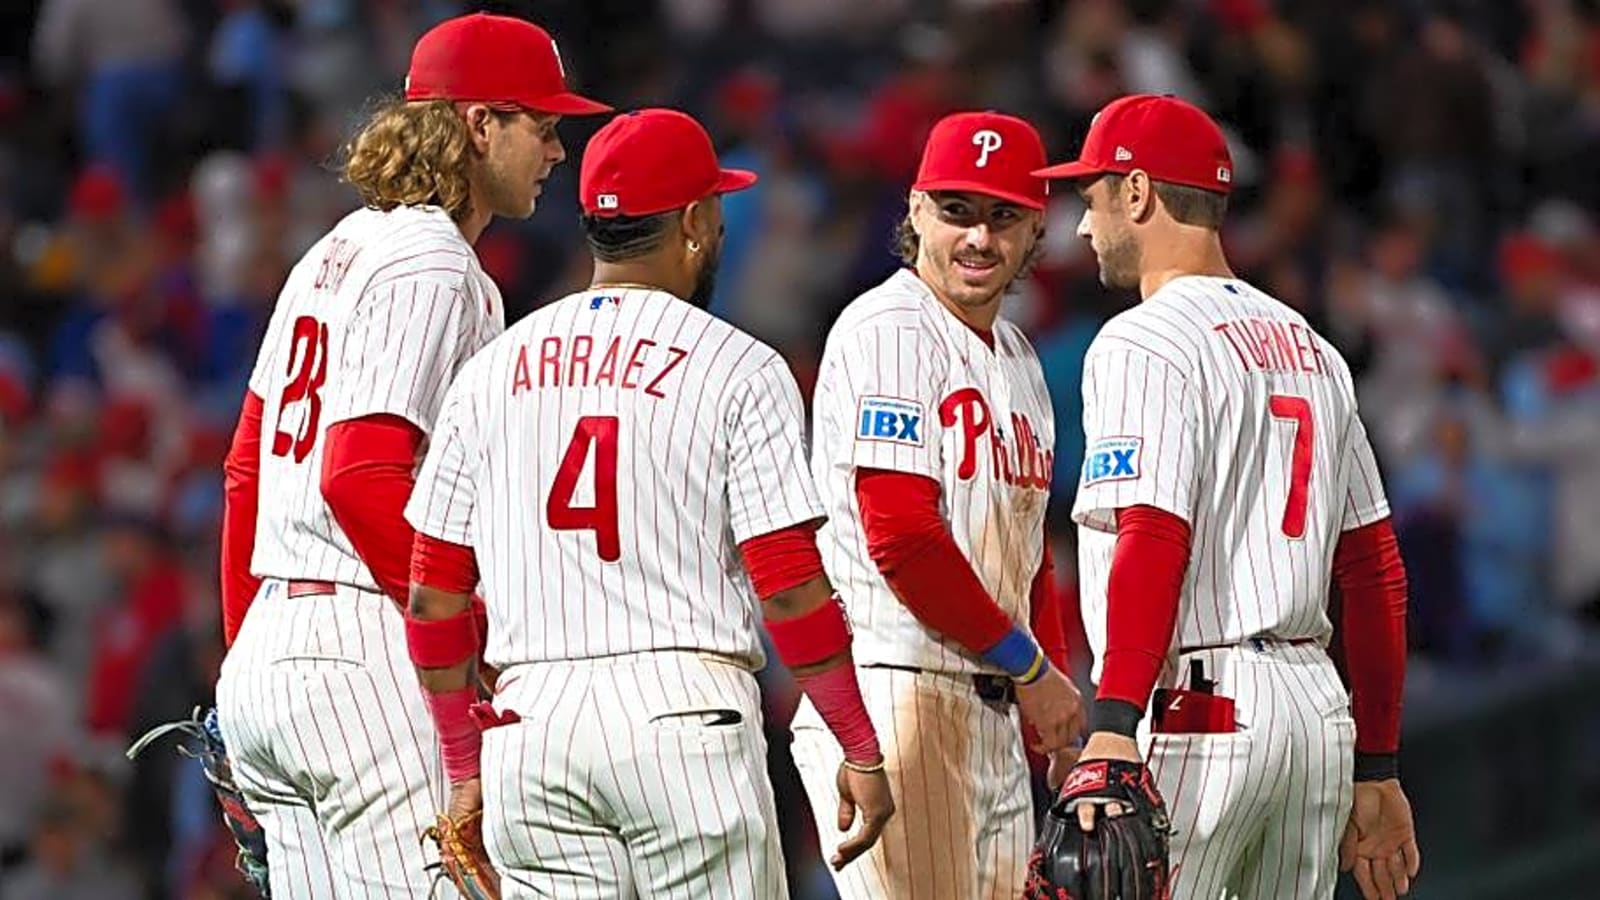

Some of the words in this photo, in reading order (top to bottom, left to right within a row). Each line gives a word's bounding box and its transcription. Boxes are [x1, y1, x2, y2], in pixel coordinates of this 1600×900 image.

[972, 130, 1002, 167] P
[512, 335, 688, 399] ARRAEZ
[860, 409, 921, 442] IBX
[546, 415, 621, 562] 4
[1269, 394, 1314, 538] 7
